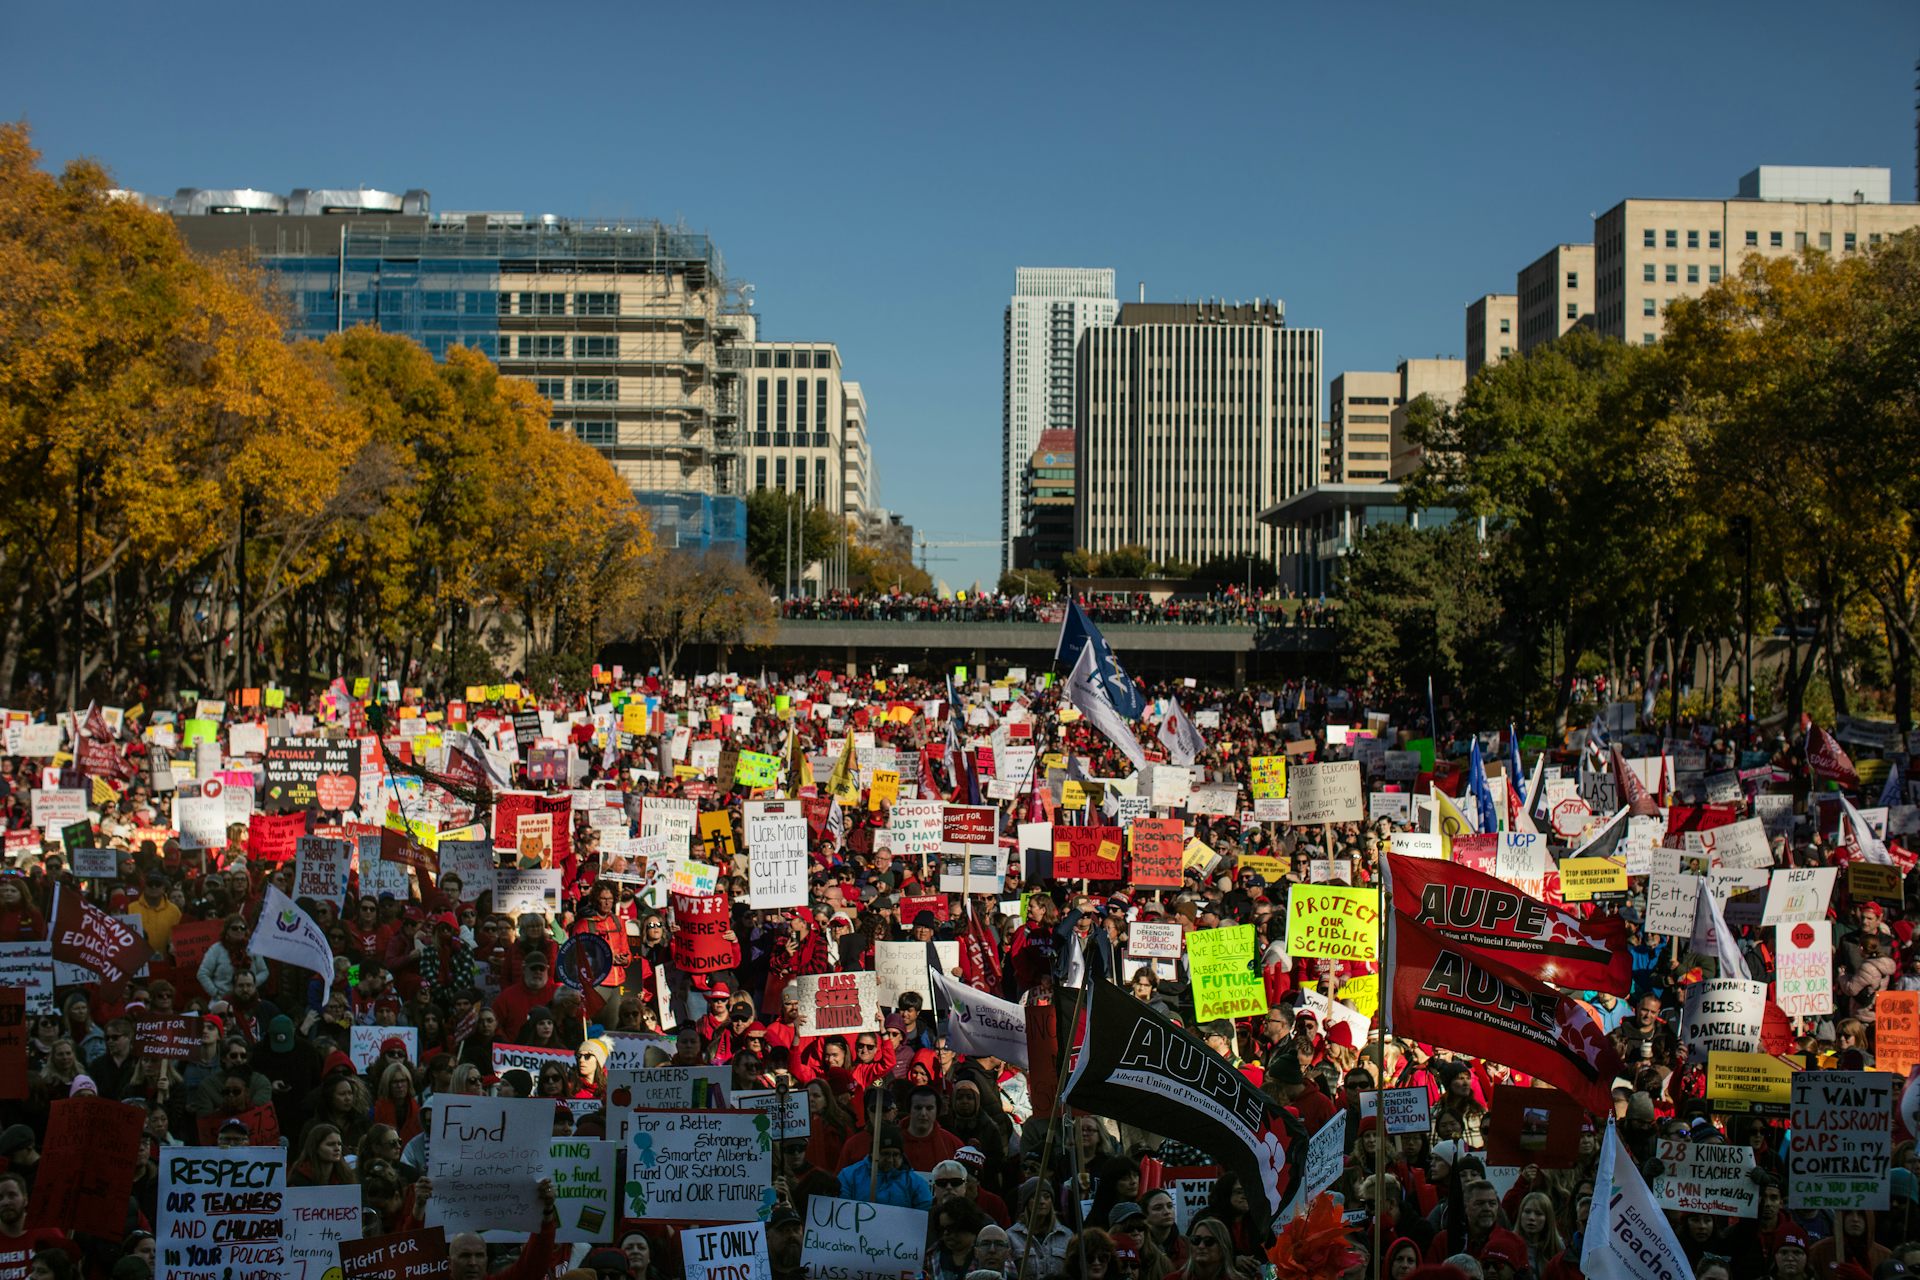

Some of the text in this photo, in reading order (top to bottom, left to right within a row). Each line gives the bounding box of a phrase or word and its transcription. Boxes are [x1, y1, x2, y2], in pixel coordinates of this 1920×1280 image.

[271, 738, 358, 748] IF THE DEAL WAS
[268, 750, 348, 760] ACTUALLY FAIR
[269, 762, 348, 772] WE WOULD HAVE
[1293, 763, 1359, 779] PUBLIC EDUCATION
[268, 772, 318, 781] VOTED YES
[875, 773, 898, 783] WTF
[1590, 773, 1609, 782] THE
[1584, 783, 1615, 800] LAST
[892, 805, 942, 817] SCHOOLS
[1561, 803, 1584, 814] STOP
[944, 812, 981, 822] FIGHT FOR
[893, 831, 942, 842] TO HAVE
[950, 833, 986, 841] EDUCATION
[1507, 833, 1536, 847] UCP
[302, 839, 337, 850] PUBLIC
[1070, 841, 1097, 857] STOP
[1135, 843, 1159, 851] rise
[1396, 840, 1432, 849] My class
[305, 851, 333, 861] MONEY
[302, 862, 336, 871] IS FOR
[683, 861, 709, 873] TURN
[755, 860, 798, 877] CUT IT
[1055, 860, 1120, 877] THE EXCUSES!
[1133, 867, 1182, 878] thrives
[1566, 868, 1620, 877] STOP UNDERFUNDING
[301, 873, 335, 883] PUBLIC
[675, 871, 713, 889] THE MIC
[1719, 876, 1744, 884] your
[1788, 870, 1815, 882] HELP!
[299, 885, 338, 895] SCHOOLS
[1651, 884, 1696, 902] Better
[675, 895, 723, 915] WTF?
[1295, 896, 1379, 925] PROTECT
[1415, 883, 1548, 935] AUPE
[1649, 903, 1693, 919] Funding
[1321, 917, 1344, 928] OUR
[1651, 921, 1691, 933] Schools
[1192, 927, 1246, 944] DANIELLE
[1306, 926, 1368, 943] PUBLIC
[1132, 942, 1178, 950] EDUCATION
[1295, 936, 1375, 959] SCHOOLS
[676, 953, 732, 968] FUNDING
[1193, 962, 1238, 974] ALBERTA'S
[1779, 965, 1826, 979] TEACHERS
[818, 974, 856, 989] CLASS
[1202, 972, 1261, 988] FUTURE
[1784, 979, 1828, 992] FOR YOUR
[1202, 987, 1255, 1000] NOT YOUR
[1422, 949, 1560, 1031] AUPE
[816, 989, 859, 1008] SIZE
[1779, 994, 1830, 1015] MISTAKES
[1202, 999, 1262, 1017] AGENDA
[1702, 1001, 1742, 1013] BLISS
[1881, 999, 1914, 1015] OUR
[816, 1005, 863, 1029] MATTERS
[1418, 998, 1558, 1047] Alberta Union of Provincial Employees
[1878, 1018, 1911, 1031] KIDS
[136, 1020, 186, 1031] FIGHT FOR
[1690, 1022, 1745, 1039] DANIELLE
[144, 1046, 189, 1056] EDUCATION
[630, 1070, 689, 1083] TEACHERS
[1120, 1017, 1264, 1133] AUPE
[1808, 1073, 1821, 1082] be
[1824, 1074, 1855, 1085] clear,
[646, 1087, 682, 1099] CREATE
[1795, 1086, 1888, 1107] I WANT
[1115, 1072, 1258, 1149] Alberta Union of Provincial Employees
[442, 1105, 507, 1142] Fund
[1791, 1110, 1889, 1132] CLASSROOM
[460, 1145, 539, 1160] Education
[1661, 1142, 1743, 1163] 28 KINDERS
[1791, 1133, 1883, 1158] CAPS in my
[656, 1148, 762, 1163] Smarter Alberta:
[170, 1157, 283, 1188] RESPECT
[435, 1162, 543, 1177] I'd rather be
[633, 1165, 661, 1180] Fund
[665, 1165, 688, 1180] OUR
[1667, 1163, 1741, 1180] 1 TEACHER
[1791, 1156, 1890, 1180] CONTRACT!
[450, 1181, 511, 1195] Teaching
[646, 1183, 766, 1203] Fund OUR FUTURE
[166, 1192, 283, 1213] OUR TEACHERS
[292, 1207, 359, 1222] TEACHERS
[441, 1209, 471, 1218] this
[812, 1198, 877, 1234] UCP
[171, 1219, 284, 1243] AND CHILDREN
[319, 1227, 342, 1240] the
[1625, 1205, 1672, 1258] Edmonton
[696, 1231, 759, 1261] IF ONLY
[165, 1245, 284, 1267] IN YOUR POLICIES,
[290, 1245, 333, 1265] learning
[343, 1239, 419, 1273] FIGHT FOR
[707, 1264, 750, 1280] KIDS
